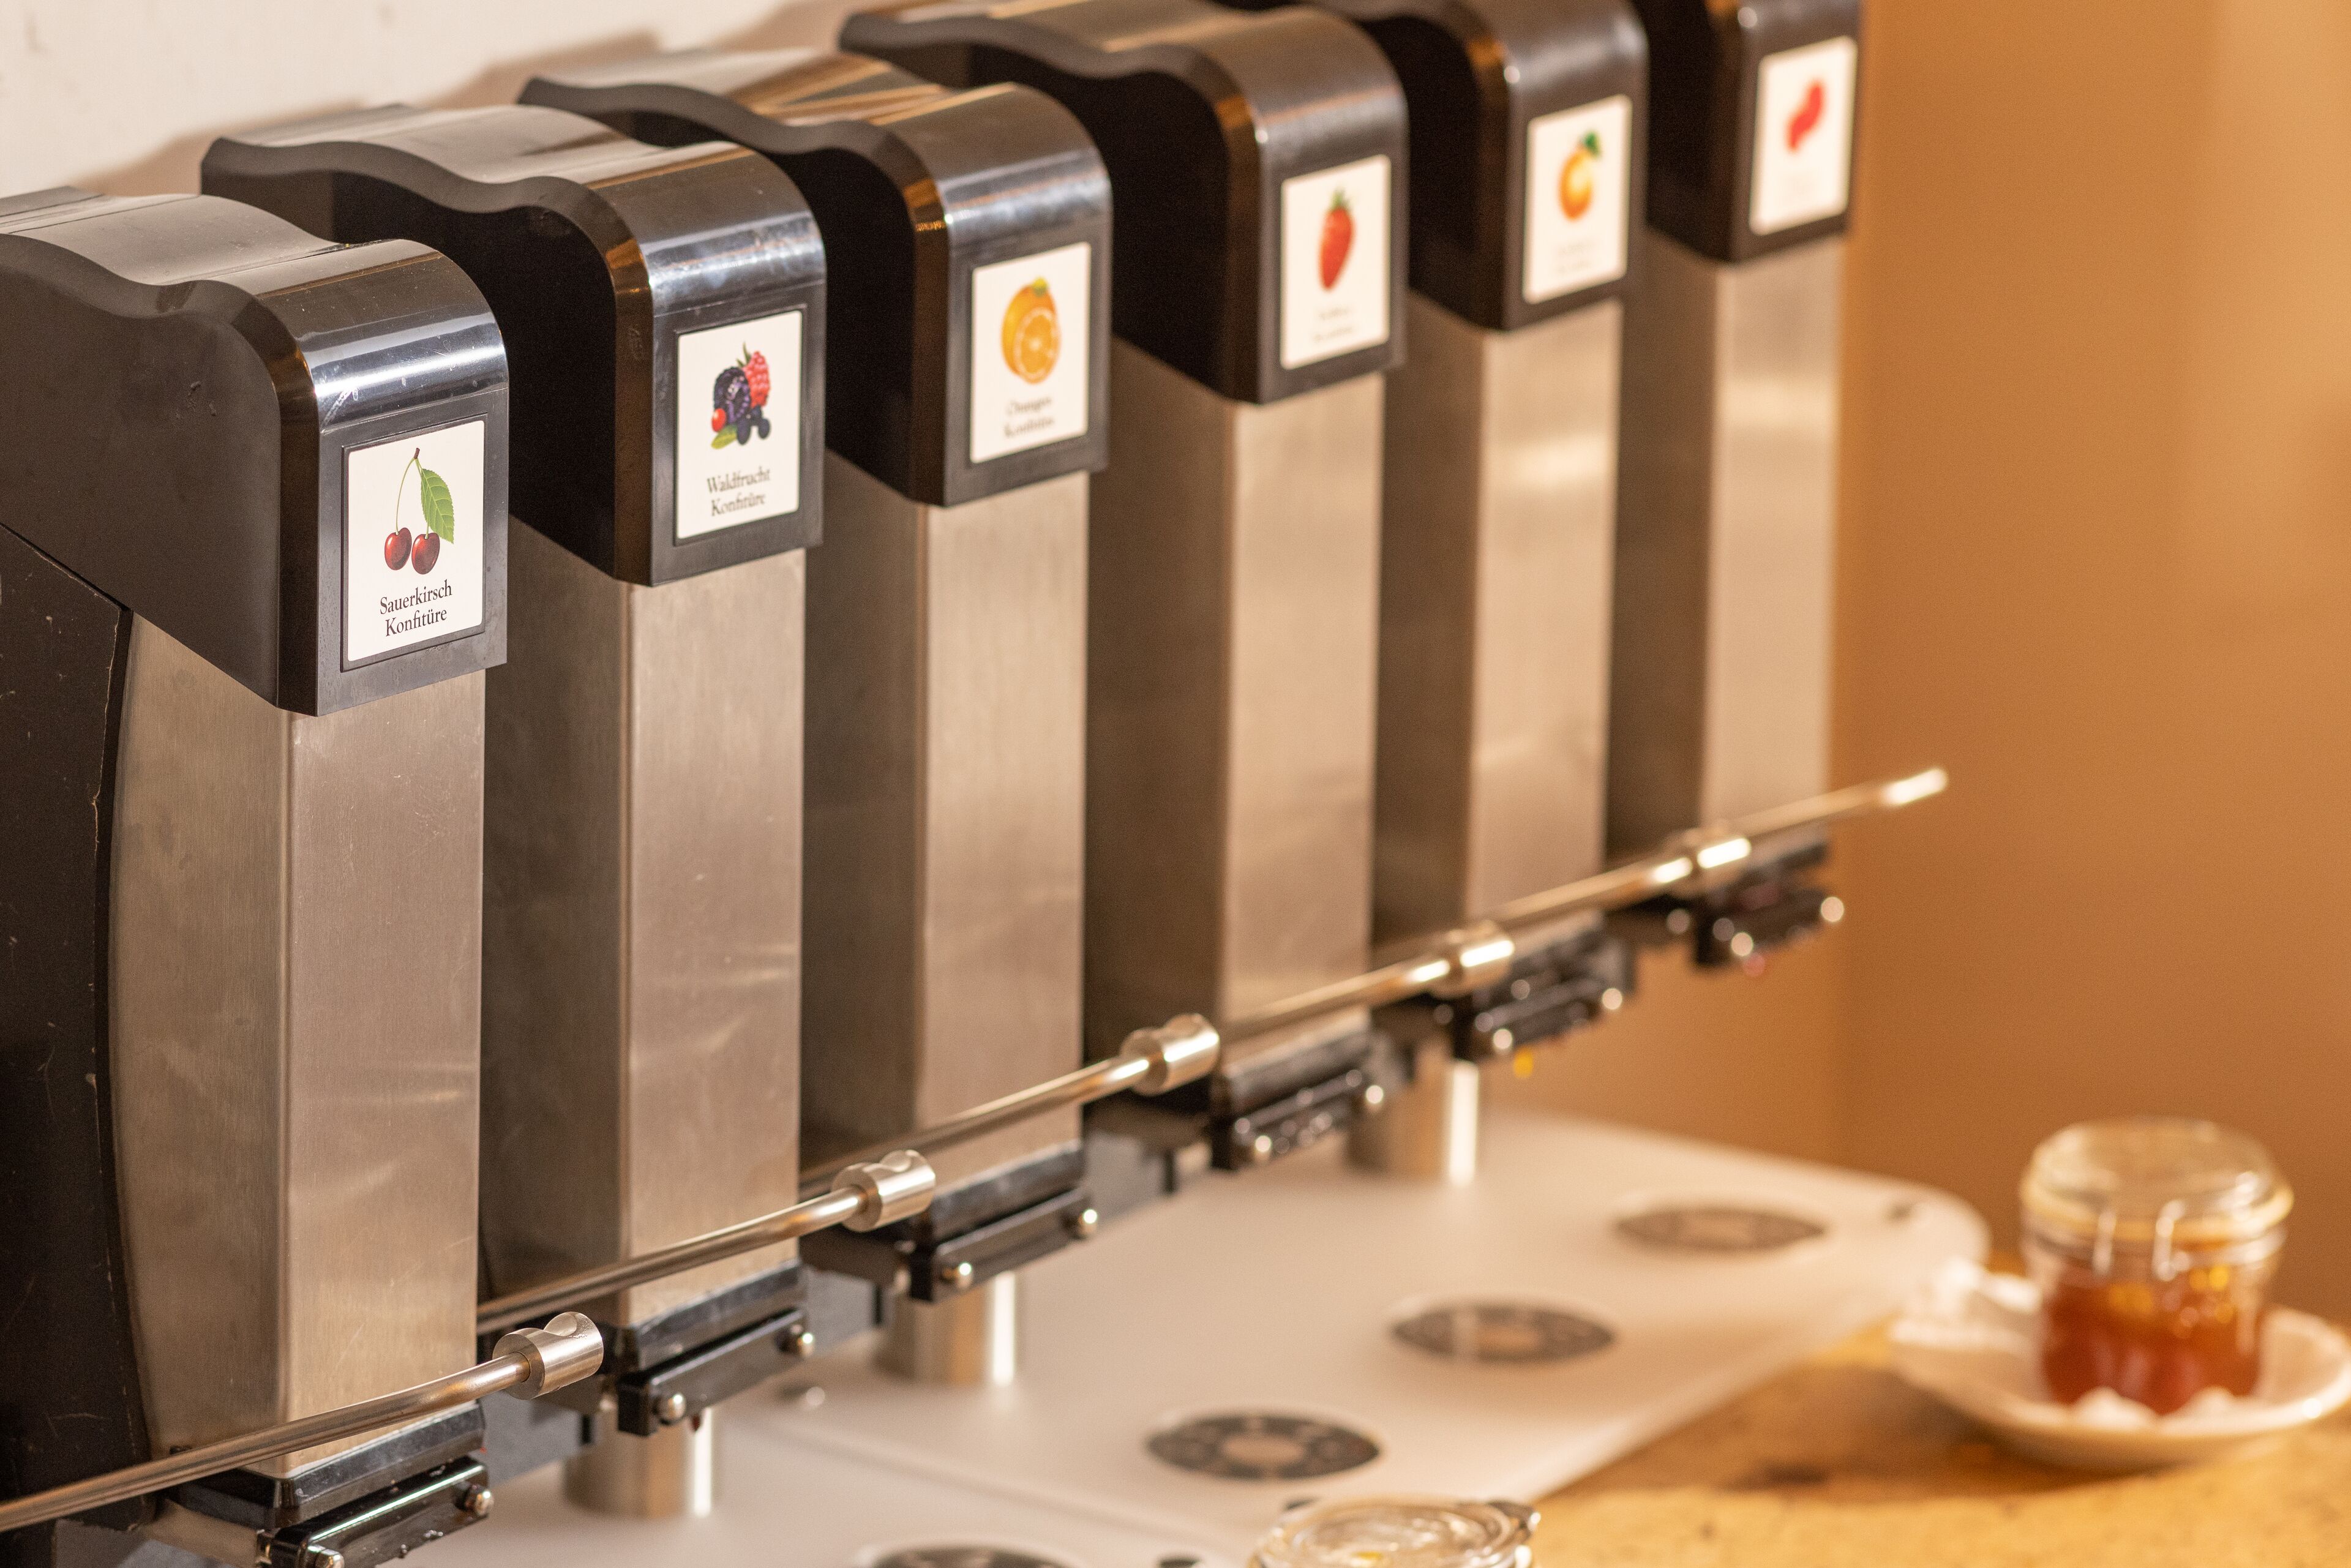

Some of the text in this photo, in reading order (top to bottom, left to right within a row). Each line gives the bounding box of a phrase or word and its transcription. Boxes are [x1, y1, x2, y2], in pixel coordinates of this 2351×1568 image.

[707, 465, 770, 493] Waldfrucht
[711, 492, 765, 516] Konfitüre
[380, 579, 452, 614] Sauerkirsch
[385, 609, 447, 637] Konfitüre
